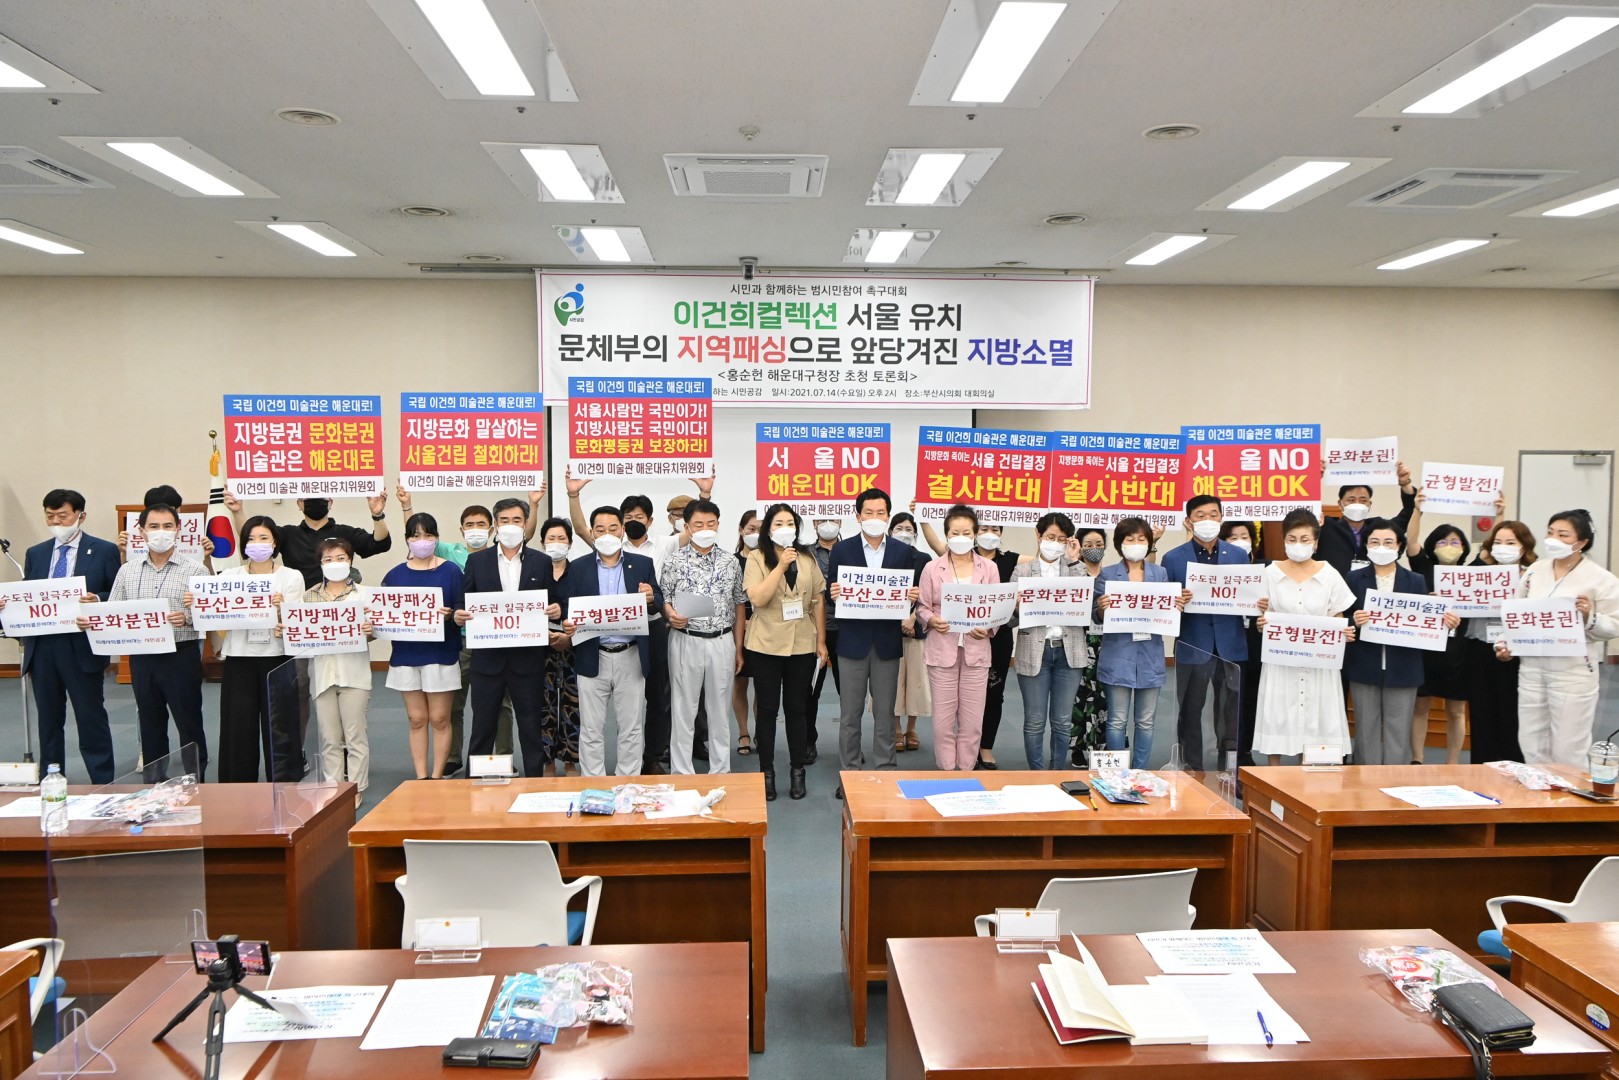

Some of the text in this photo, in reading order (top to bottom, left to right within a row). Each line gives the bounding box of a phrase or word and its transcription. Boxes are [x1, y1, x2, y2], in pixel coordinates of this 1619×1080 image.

[730, 284, 908, 297] 시민과 함께하는 범시민참여 촉구대회
[674, 301, 962, 332] 이건희컬렉션 서울 유치
[558, 334, 1073, 367] 문체부의 지역패싱으로 앞당겨진 지방소멸
[767, 369, 840, 383] 해운대구청장
[844, 370, 868, 383] 초청
[576, 380, 705, 394] 국립 이건희 미술관은 해운대로!
[731, 388, 762, 397] 시민공감
[964, 390, 995, 398] 대회의실
[232, 399, 373, 413] 국립 이건희 미술관은 해운대로!
[408, 396, 536, 408] 국립 이건희 미술관은 해운대로!
[574, 403, 707, 419] 서울사람만 국민이가!
[233, 421, 375, 446] 지방분권 문화분권
[406, 418, 538, 439] 지방문화 말살하는
[575, 421, 707, 436] 지방사람도 국민이다!
[763, 426, 884, 439] 국립 이건희 미술관은 해운대로!
[1188, 427, 1313, 441] 국립 이건희 미술관은 해운대로!
[575, 438, 707, 454] 문화평등권 보장하라!
[926, 430, 1047, 447] 국립 이건희 미술관은 해운대로!
[1060, 435, 1180, 451] 국립 이건희 미술관은 해운대로!
[234, 449, 376, 474] 미술관은 해운대로
[405, 445, 538, 466] 서울건립 철회하라!
[841, 446, 880, 470] NO
[923, 450, 1046, 471] 지방문화 죽이는 서울 건립결정
[1268, 447, 1310, 470] NO
[1327, 448, 1395, 464] 문화분권!
[577, 461, 705, 474] 이건희 미술관 해운대유치위원회
[1058, 455, 1180, 475] 지방문화 죽이는 서울 건립결정
[236, 480, 376, 495] 이건희 미술관 해운대유치위원회
[408, 475, 536, 487] 이건희 미술관 해운대유치위원회
[767, 473, 878, 497] 해운대 OK
[927, 471, 1042, 504] 결사반대
[1192, 474, 1310, 499] 해운대 OK
[1425, 474, 1498, 493] 균형발전!
[1062, 477, 1176, 507] 결사반대
[792, 504, 816, 516] 미술관
[922, 507, 947, 519] 이건희
[1084, 512, 1109, 525] 미술관
[194, 580, 272, 594] 이건희미술관
[841, 572, 911, 587] 이건희미술관
[1188, 573, 1262, 585] 수도권 일극주의
[1440, 571, 1511, 587] 지방패싱
[1, 588, 83, 603] 수도권 일극주의
[370, 592, 436, 610] 지방패싱
[840, 586, 909, 602] 부산으로!
[944, 591, 1015, 604] 수도권 일극주의
[1021, 587, 1090, 604] 문화분권!
[1211, 587, 1237, 599] NO!
[29, 603, 58, 618] NO!
[194, 595, 273, 613] 부산으로!
[468, 601, 545, 614] 수도권 일극주의
[1370, 596, 1447, 614] 이건희미술관
[287, 606, 357, 623] 지방패싱
[369, 609, 440, 627] 분노한다!
[571, 605, 644, 626] 균형발전!
[966, 606, 992, 619] NO!
[1369, 610, 1444, 630] 부산으로!
[1504, 610, 1580, 630] 문화분권!
[88, 611, 167, 632] 문화분권!
[493, 615, 521, 630] NO!
[285, 624, 362, 642] 분노한다!
[1266, 624, 1343, 646] 균형발전!
